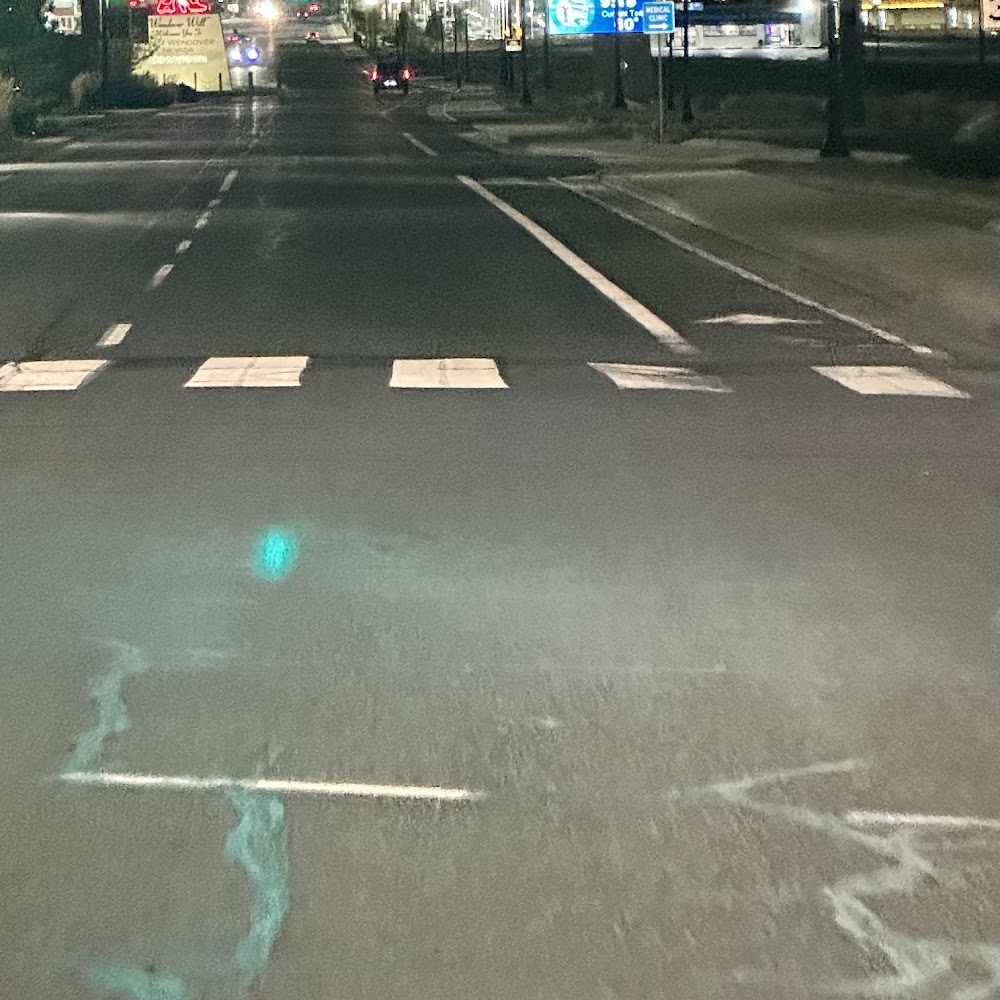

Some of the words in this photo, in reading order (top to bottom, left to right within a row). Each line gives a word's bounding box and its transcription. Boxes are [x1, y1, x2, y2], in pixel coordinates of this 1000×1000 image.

[645, 6, 671, 14] MEDICAL
[602, 10, 629, 19] Curnt
[648, 14, 669, 22] CLINIC
